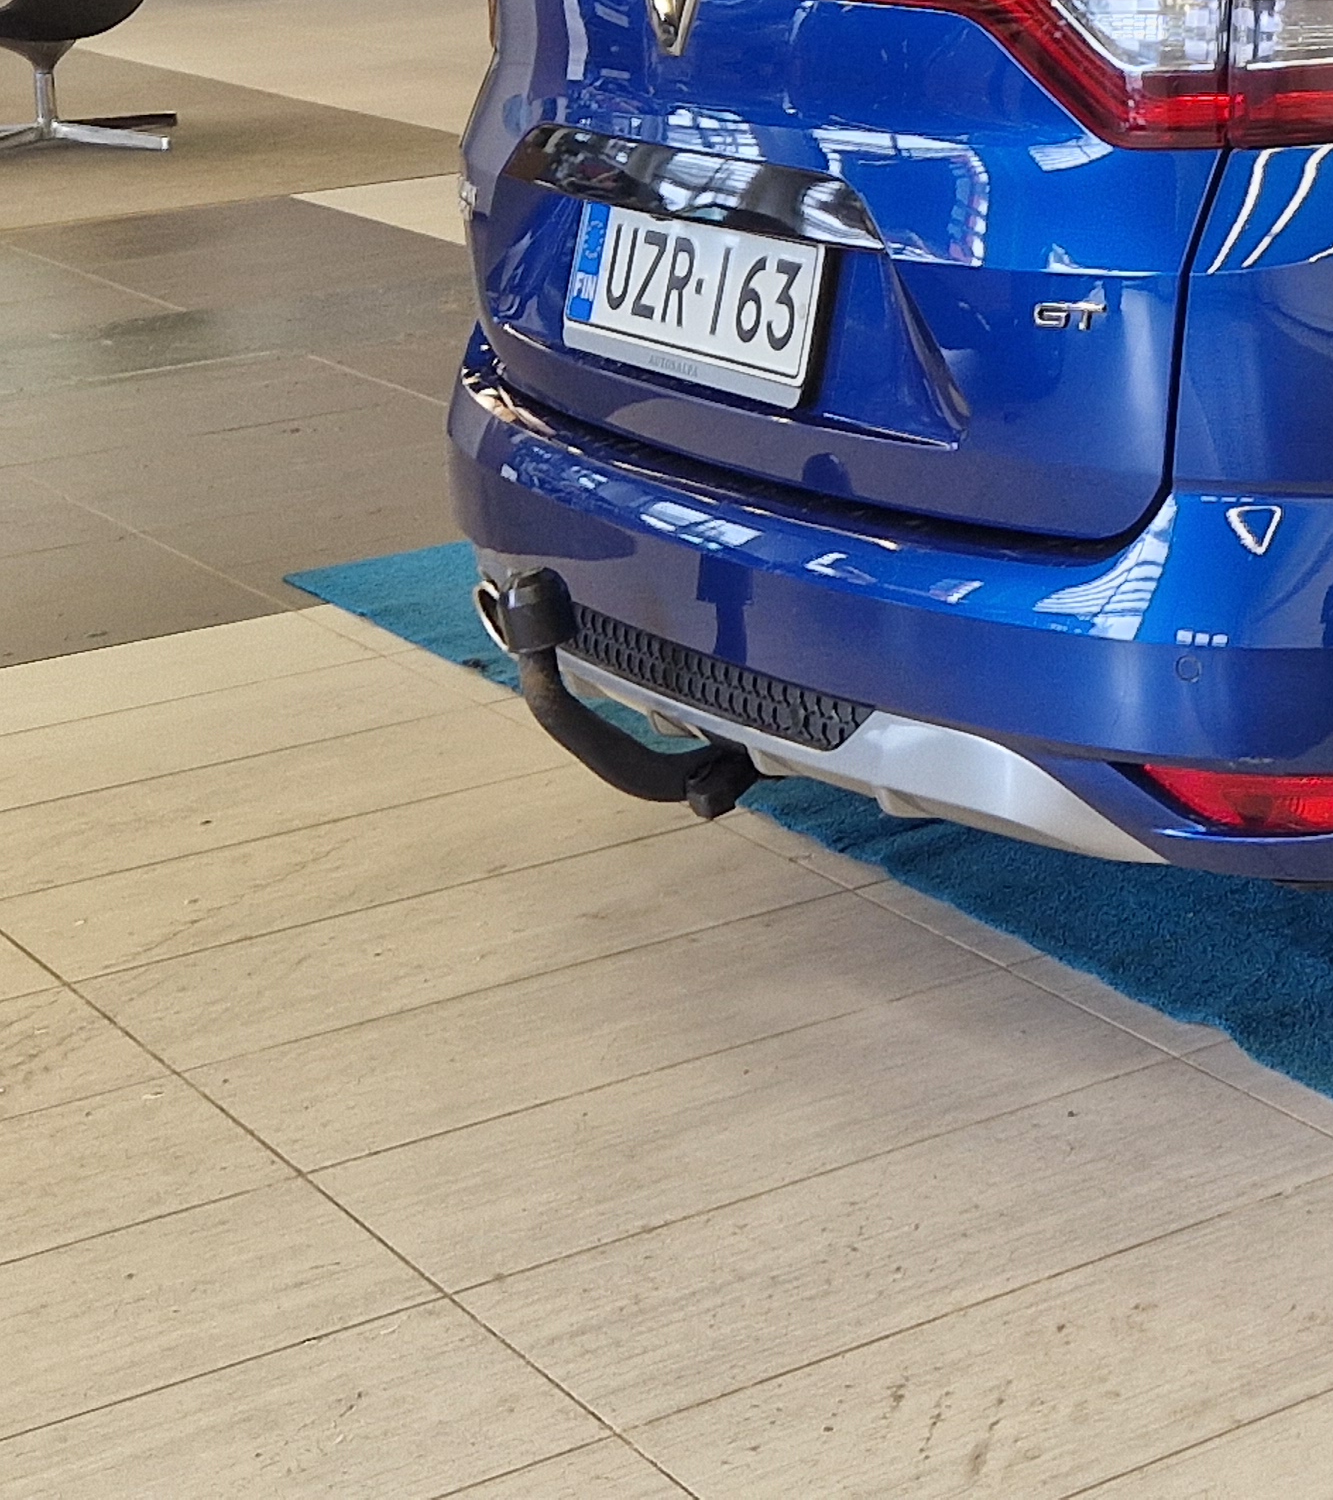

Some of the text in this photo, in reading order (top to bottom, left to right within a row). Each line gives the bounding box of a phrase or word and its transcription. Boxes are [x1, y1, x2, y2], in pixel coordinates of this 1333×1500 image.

[573, 271, 599, 302] FIN
[606, 223, 803, 351] UZR-163
[1033, 301, 1108, 331] GT
